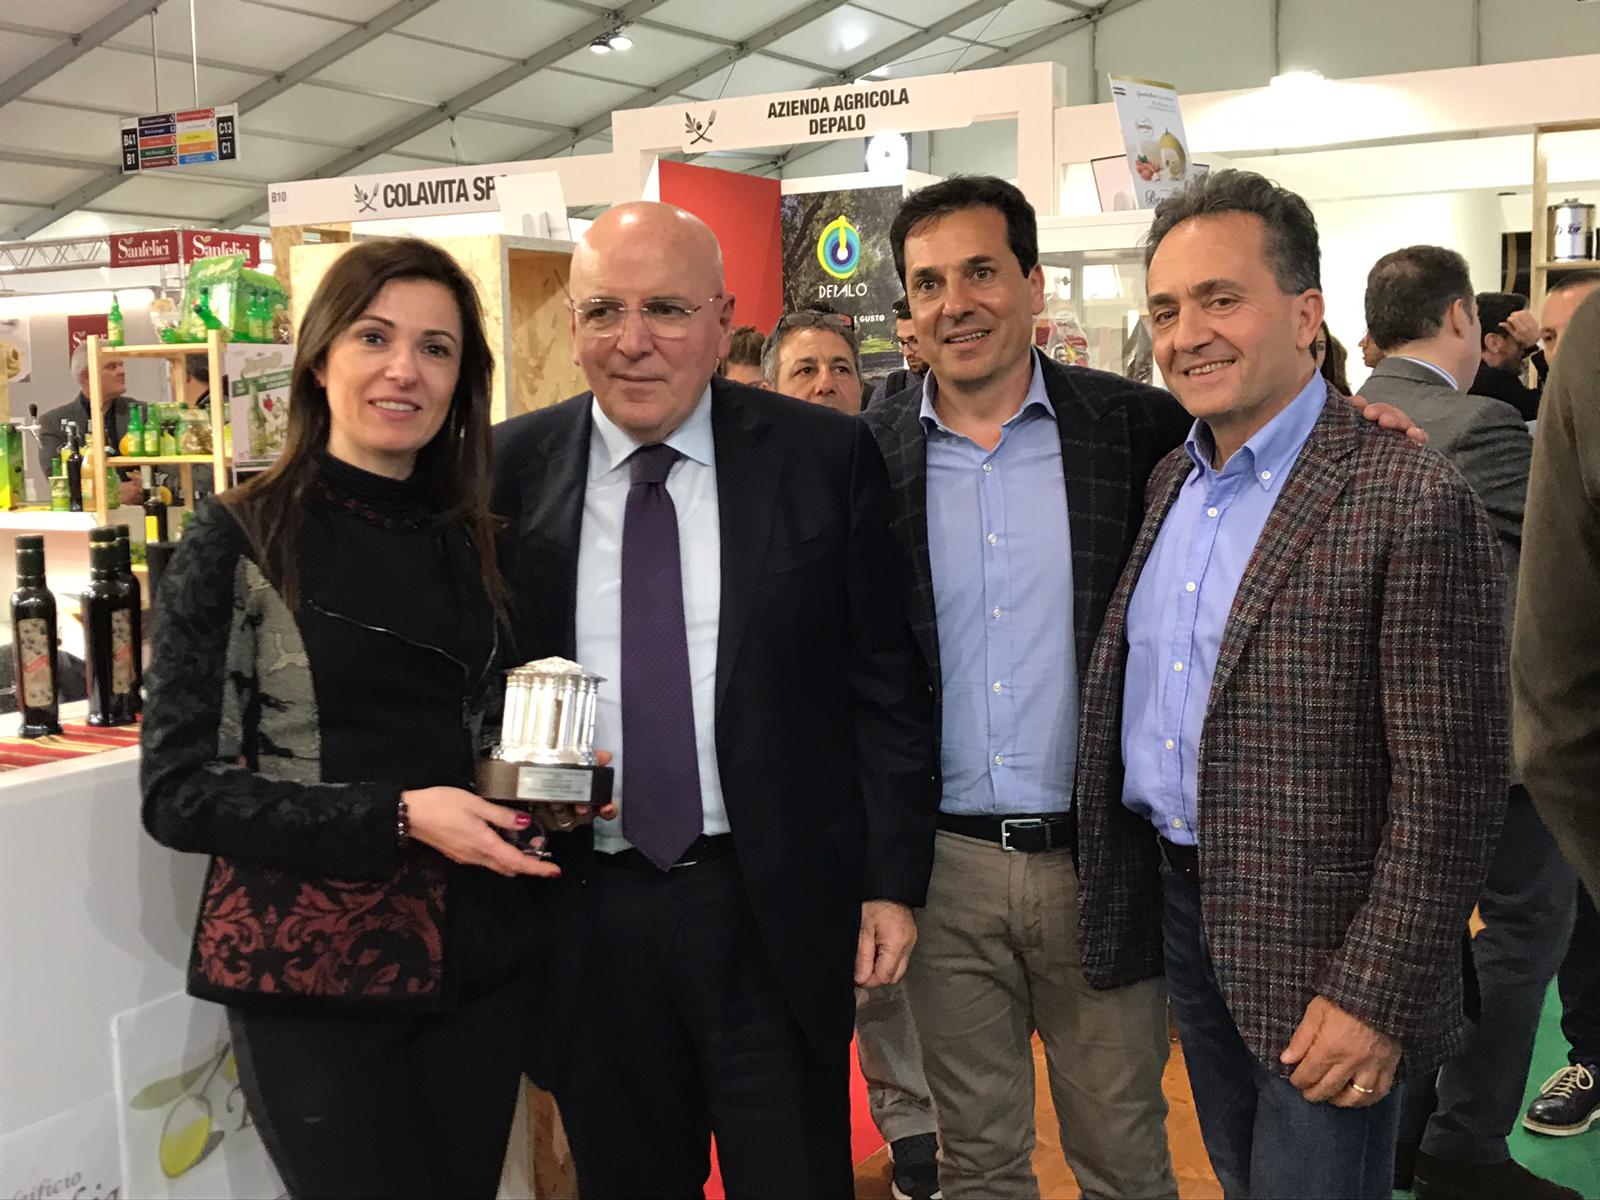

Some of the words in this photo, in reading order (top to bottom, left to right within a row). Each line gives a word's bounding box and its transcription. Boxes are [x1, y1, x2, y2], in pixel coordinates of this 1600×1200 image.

[767, 97, 830, 119] AZIENDA
[833, 88, 910, 112] AGRICOLA
[218, 121, 233, 135] C13
[809, 113, 866, 136] DEPALO
[123, 133, 137, 146] B41
[221, 141, 232, 154] C1
[126, 153, 136, 165] B1
[271, 191, 287, 203] B10
[383, 177, 469, 208] COLAVITA
[473, 174, 506, 201] SP
[117, 237, 170, 260] Sanfelici
[818, 282, 868, 299] DEPALO
[859, 314, 886, 323] GUSTO
